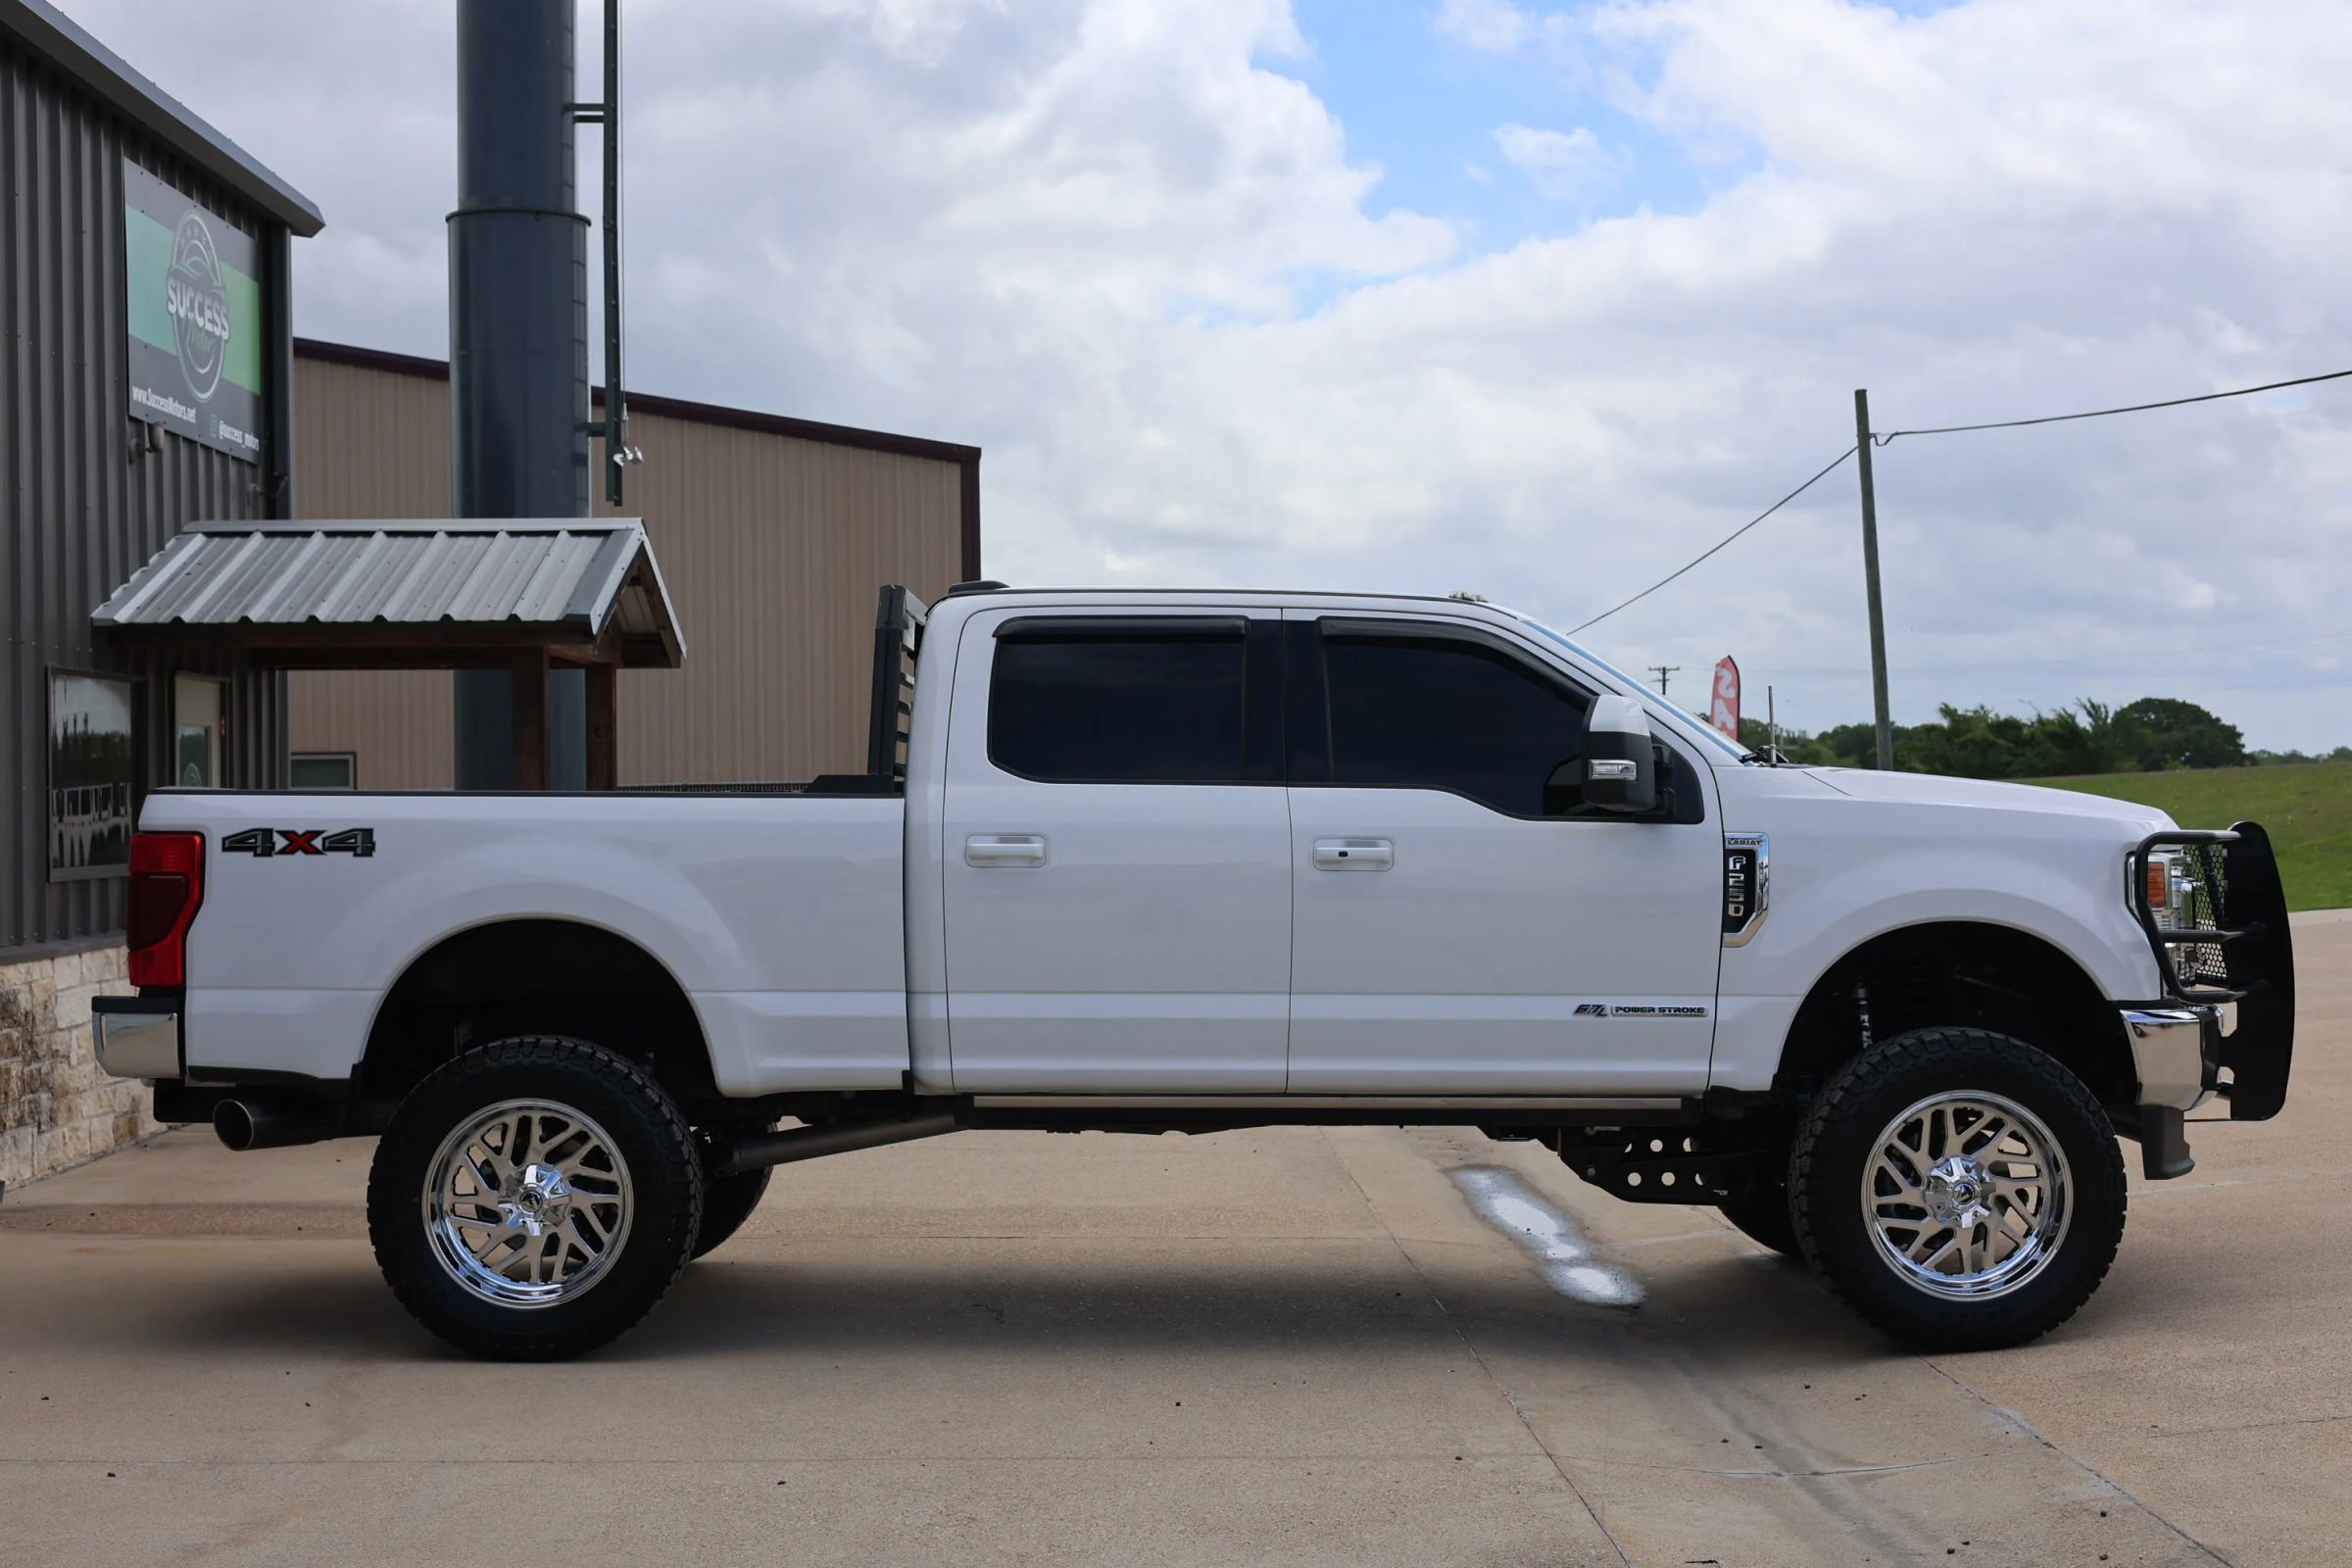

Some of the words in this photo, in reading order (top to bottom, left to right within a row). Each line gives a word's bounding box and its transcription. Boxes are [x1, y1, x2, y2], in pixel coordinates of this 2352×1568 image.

[167, 276, 229, 341] SUCCESS
[1615, 1005, 1656, 1014] POWER
[1658, 1005, 1706, 1014] STROKE
